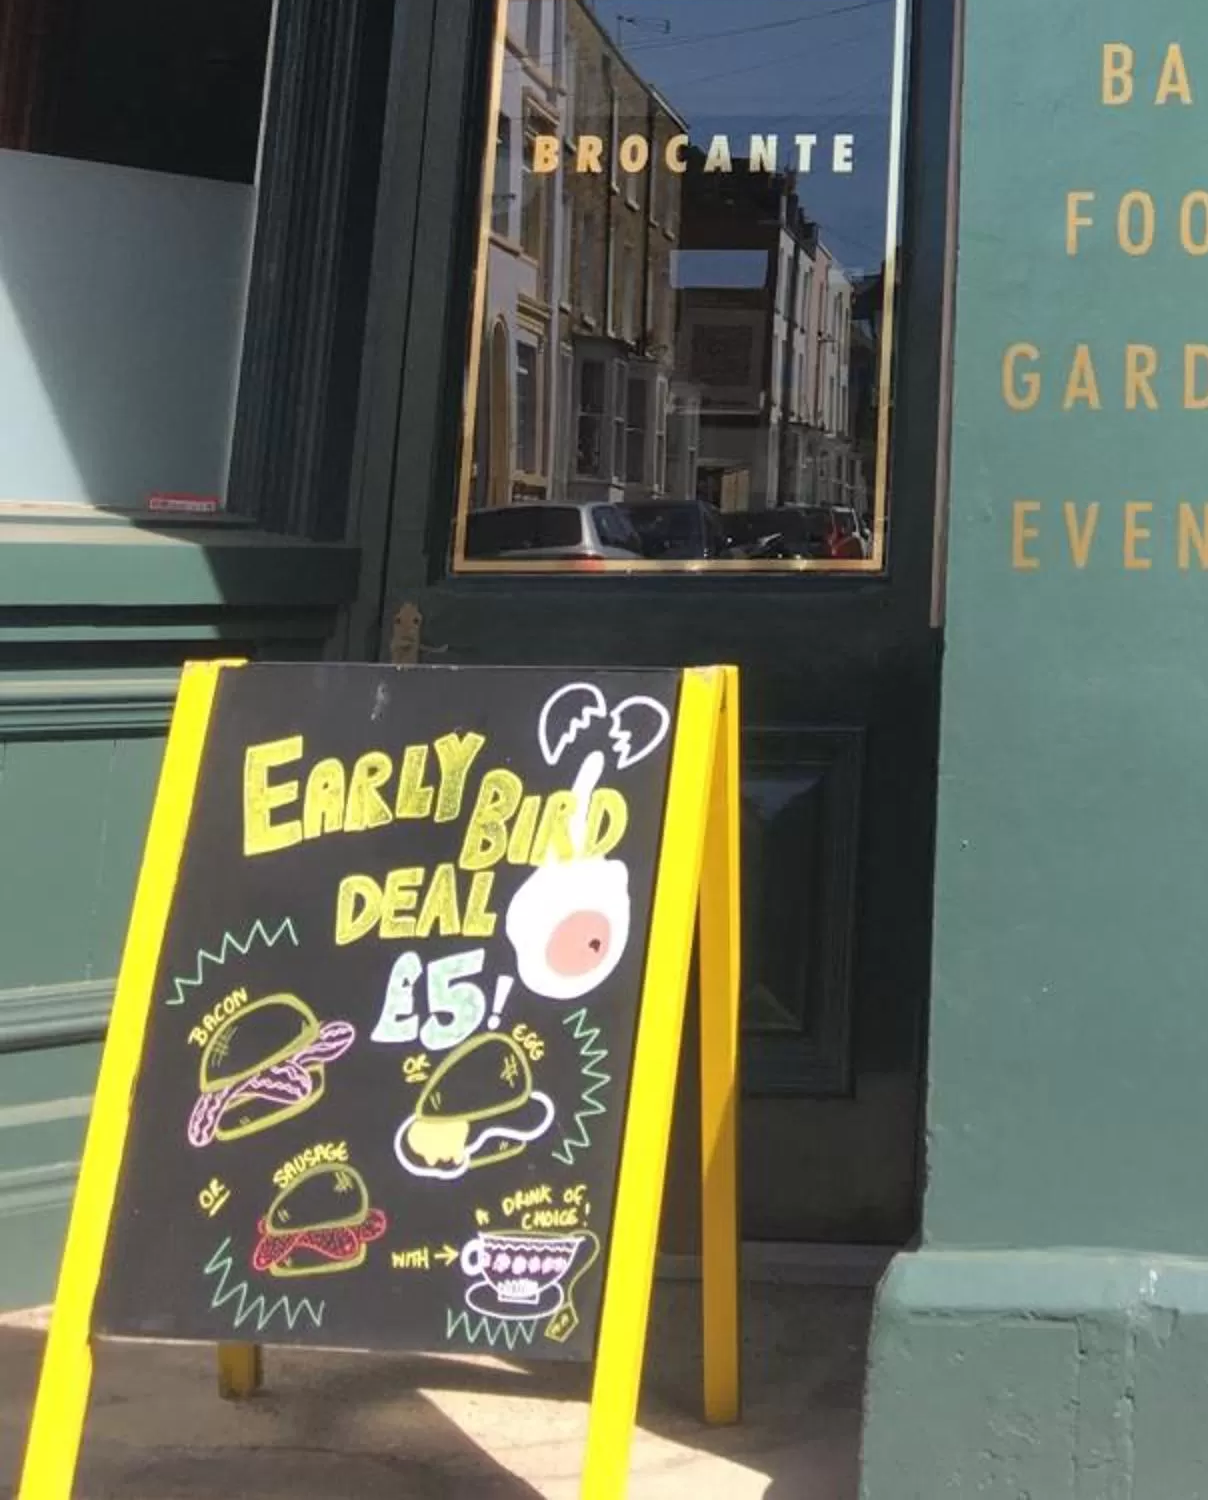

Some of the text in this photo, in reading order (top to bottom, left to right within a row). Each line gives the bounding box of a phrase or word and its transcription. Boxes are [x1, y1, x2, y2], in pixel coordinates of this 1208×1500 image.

[533, 132, 855, 174] BROCANTE
[243, 732, 628, 871] EARLY BIRD
[335, 863, 497, 945] DEAL
[188, 987, 248, 1048] BACON
[371, 948, 513, 1050] £5!
[512, 1023, 544, 1061] EGG
[403, 1053, 431, 1077] OR
[273, 1141, 350, 1188] SAUSAGE
[199, 1178, 229, 1209] OR
[503, 1191, 551, 1216] DRINK
[562, 1185, 586, 1205] OF
[392, 1245, 429, 1269] WITH
